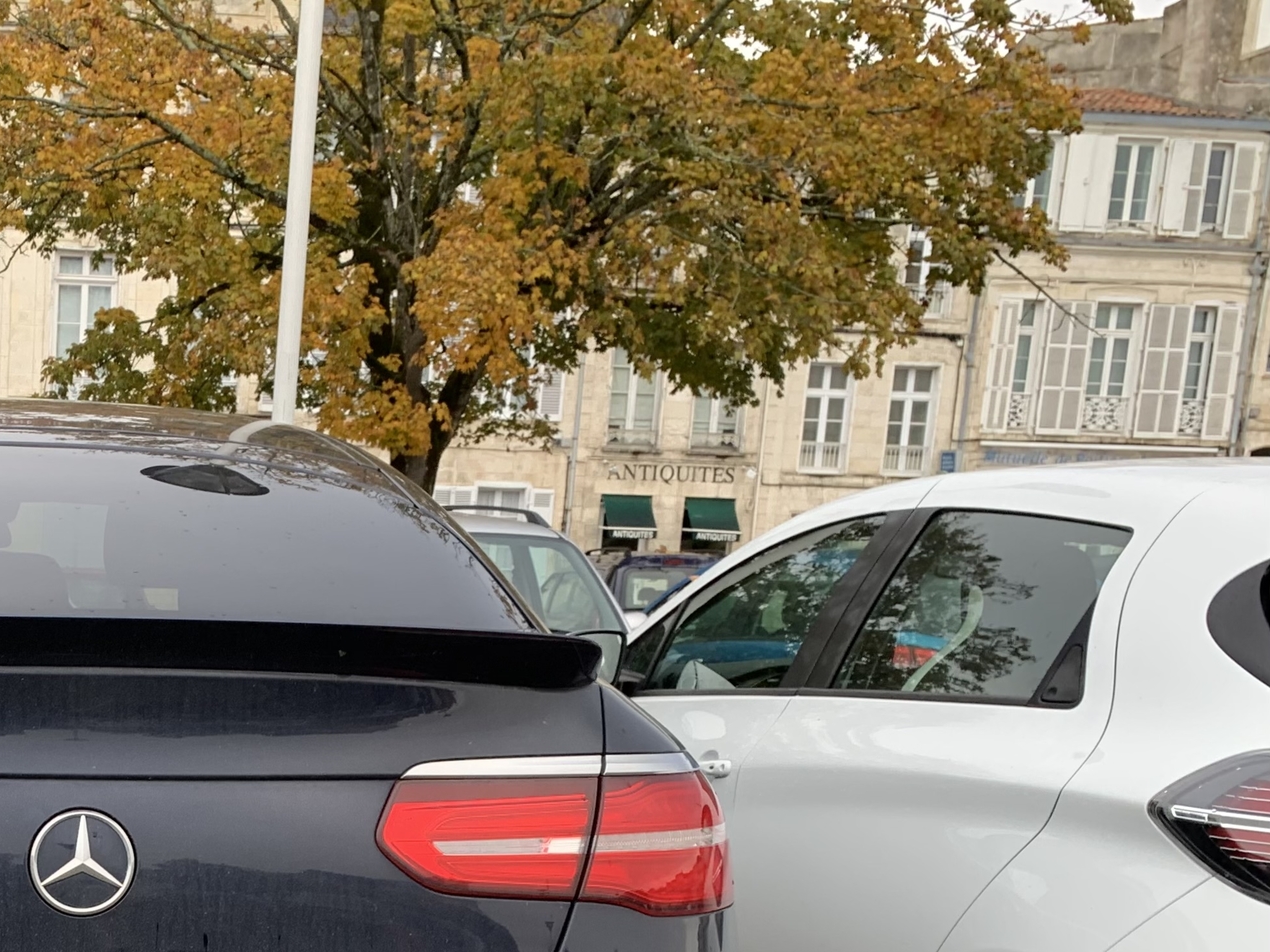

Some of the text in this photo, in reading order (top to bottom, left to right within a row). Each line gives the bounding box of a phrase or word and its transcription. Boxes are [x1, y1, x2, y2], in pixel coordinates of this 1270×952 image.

[607, 464, 735, 484] ANTIQUITES
[612, 530, 654, 539] ANTIQUITES
[696, 532, 737, 542] ANTIQUITES
